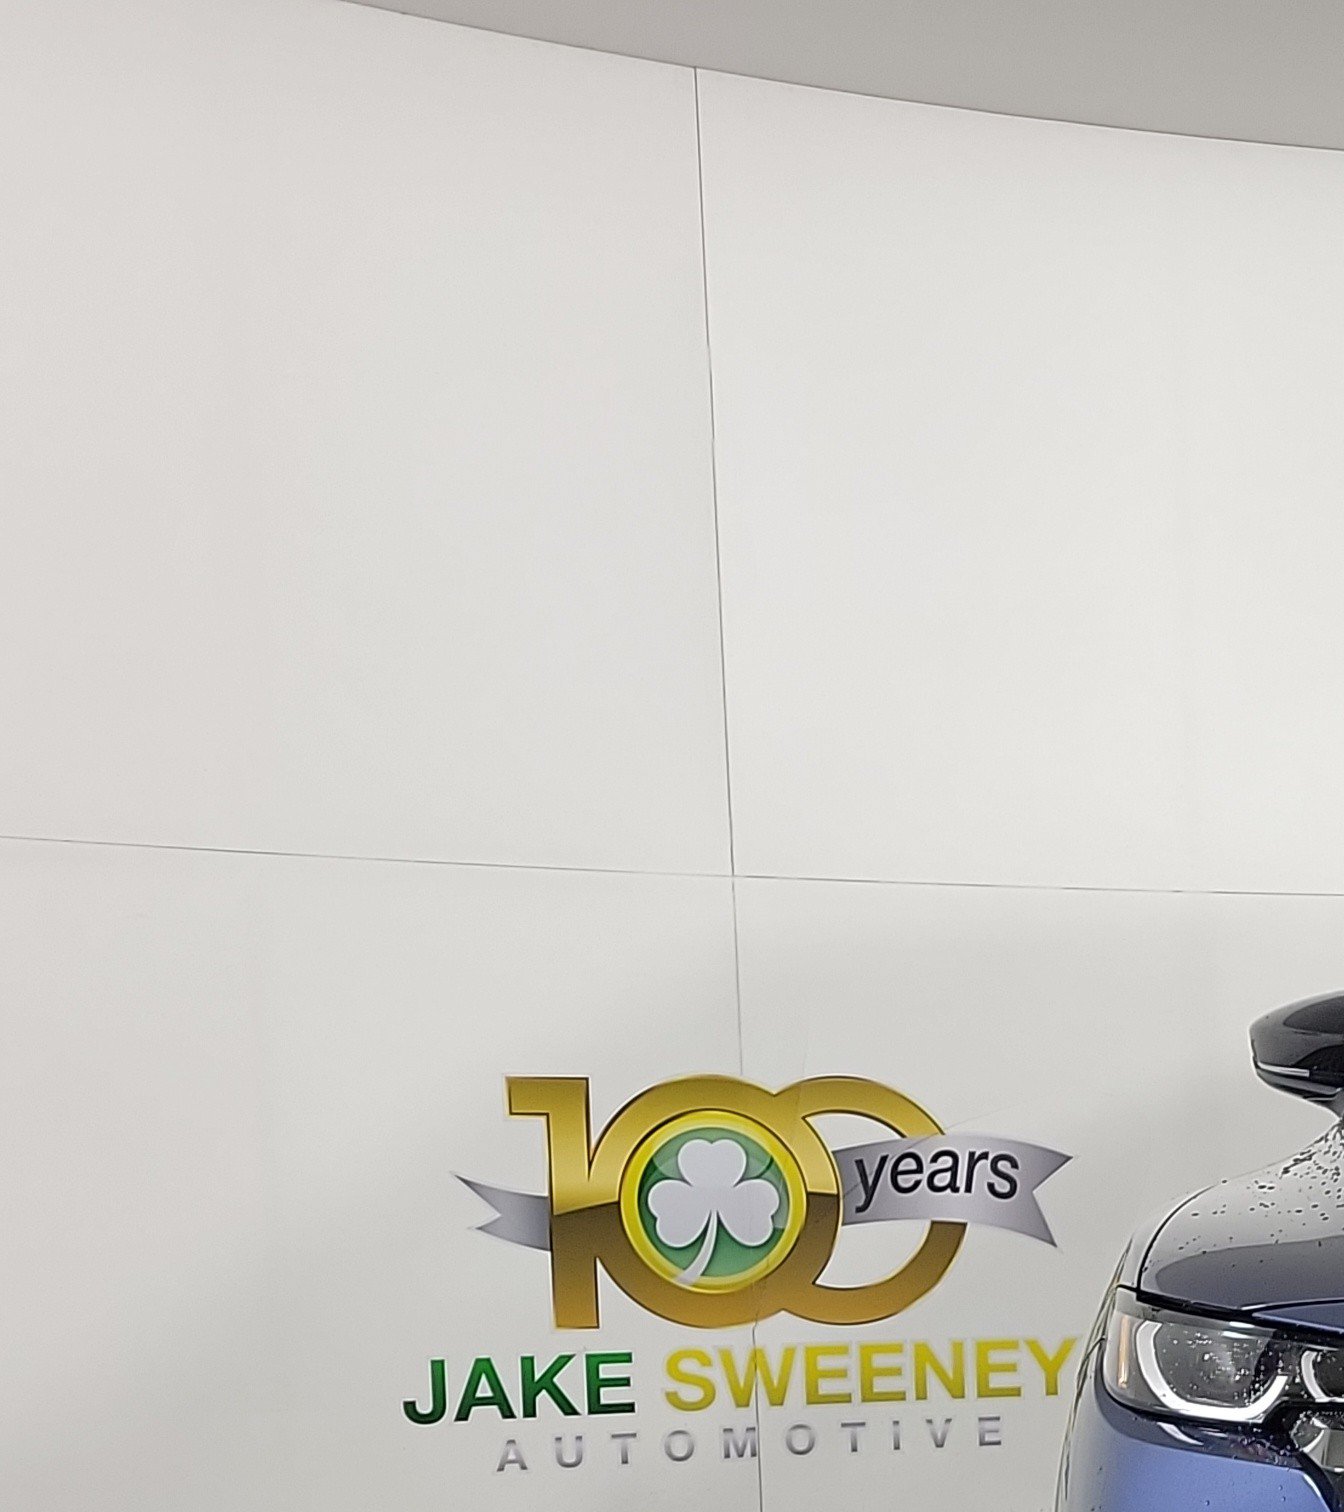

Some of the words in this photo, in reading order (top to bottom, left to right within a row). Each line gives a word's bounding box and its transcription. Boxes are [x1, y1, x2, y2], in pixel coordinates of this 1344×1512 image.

[505, 1074, 968, 1330] 100
[853, 1147, 1020, 1213] years
[402, 1351, 636, 1426] JAKE
[664, 1337, 1079, 1413] SWEENEY
[496, 1415, 1002, 1472] AUTOMOTIVE
